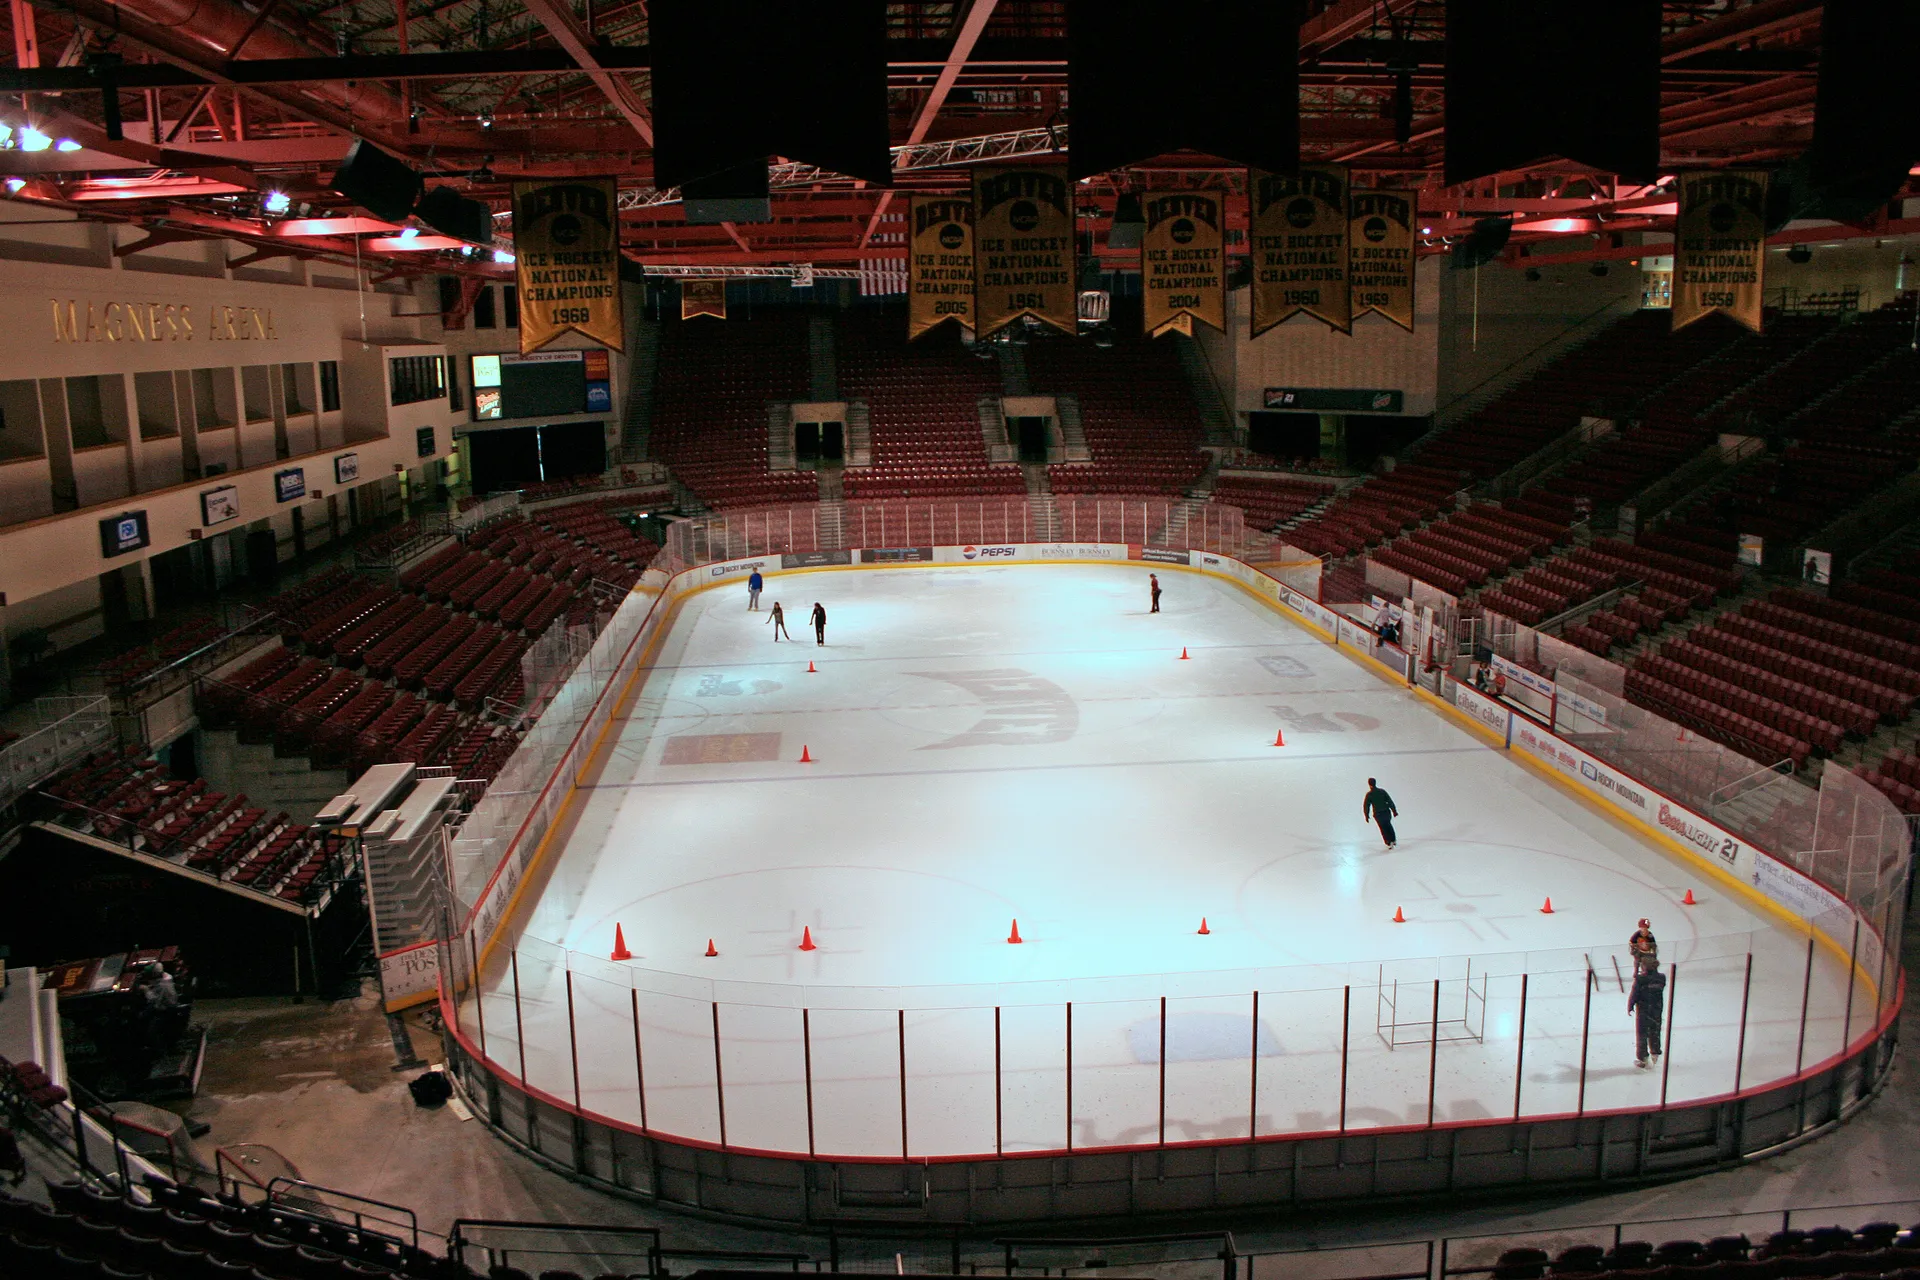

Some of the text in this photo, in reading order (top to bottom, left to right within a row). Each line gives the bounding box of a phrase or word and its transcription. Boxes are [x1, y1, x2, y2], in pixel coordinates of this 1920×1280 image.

[916, 199, 974, 238] DENVE
[1351, 194, 1410, 233] ENVER
[982, 237, 1068, 251] ICE HOCKEY
[1259, 234, 1344, 249] ICE HOCKEY
[524, 251, 614, 267] ICE HOCKEY
[915, 254, 973, 266] ICE HOCK
[1149, 249, 1218, 261] ICE HOCKEY
[1266, 251, 1337, 266] NATIONAL
[1363, 247, 1409, 259] HOCKEY
[988, 254, 1062, 269] NATIONAL
[1154, 262, 1214, 275] NATIONAL
[1350, 260, 1404, 273] ATIONAL
[1688, 255, 1754, 268] NATIONAL
[532, 269, 608, 284] NATIONAL
[920, 268, 974, 281] NATIONA
[983, 271, 1069, 286] CHAMPIONS
[1261, 268, 1343, 283] CHAMPIONS
[1350, 275, 1409, 287] AMPIONS
[1682, 271, 1757, 284] CHAMPIONS
[915, 282, 974, 295] CHAMPIO
[1150, 276, 1218, 289] CHAMPIONS
[527, 285, 613, 301] CHAMPIONS
[935, 301, 968, 314] 2005
[1169, 295, 1200, 308] 2004
[50, 298, 279, 344] MAGNESS ARENA
[553, 308, 590, 325] 1968
[980, 547, 1015, 557] PEPSI
[1457, 692, 1506, 729] ciber ciber
[1597, 771, 1646, 809] ROCKY MOUNTAIN
[1657, 802, 1739, 861] Coors LIGHT 21
